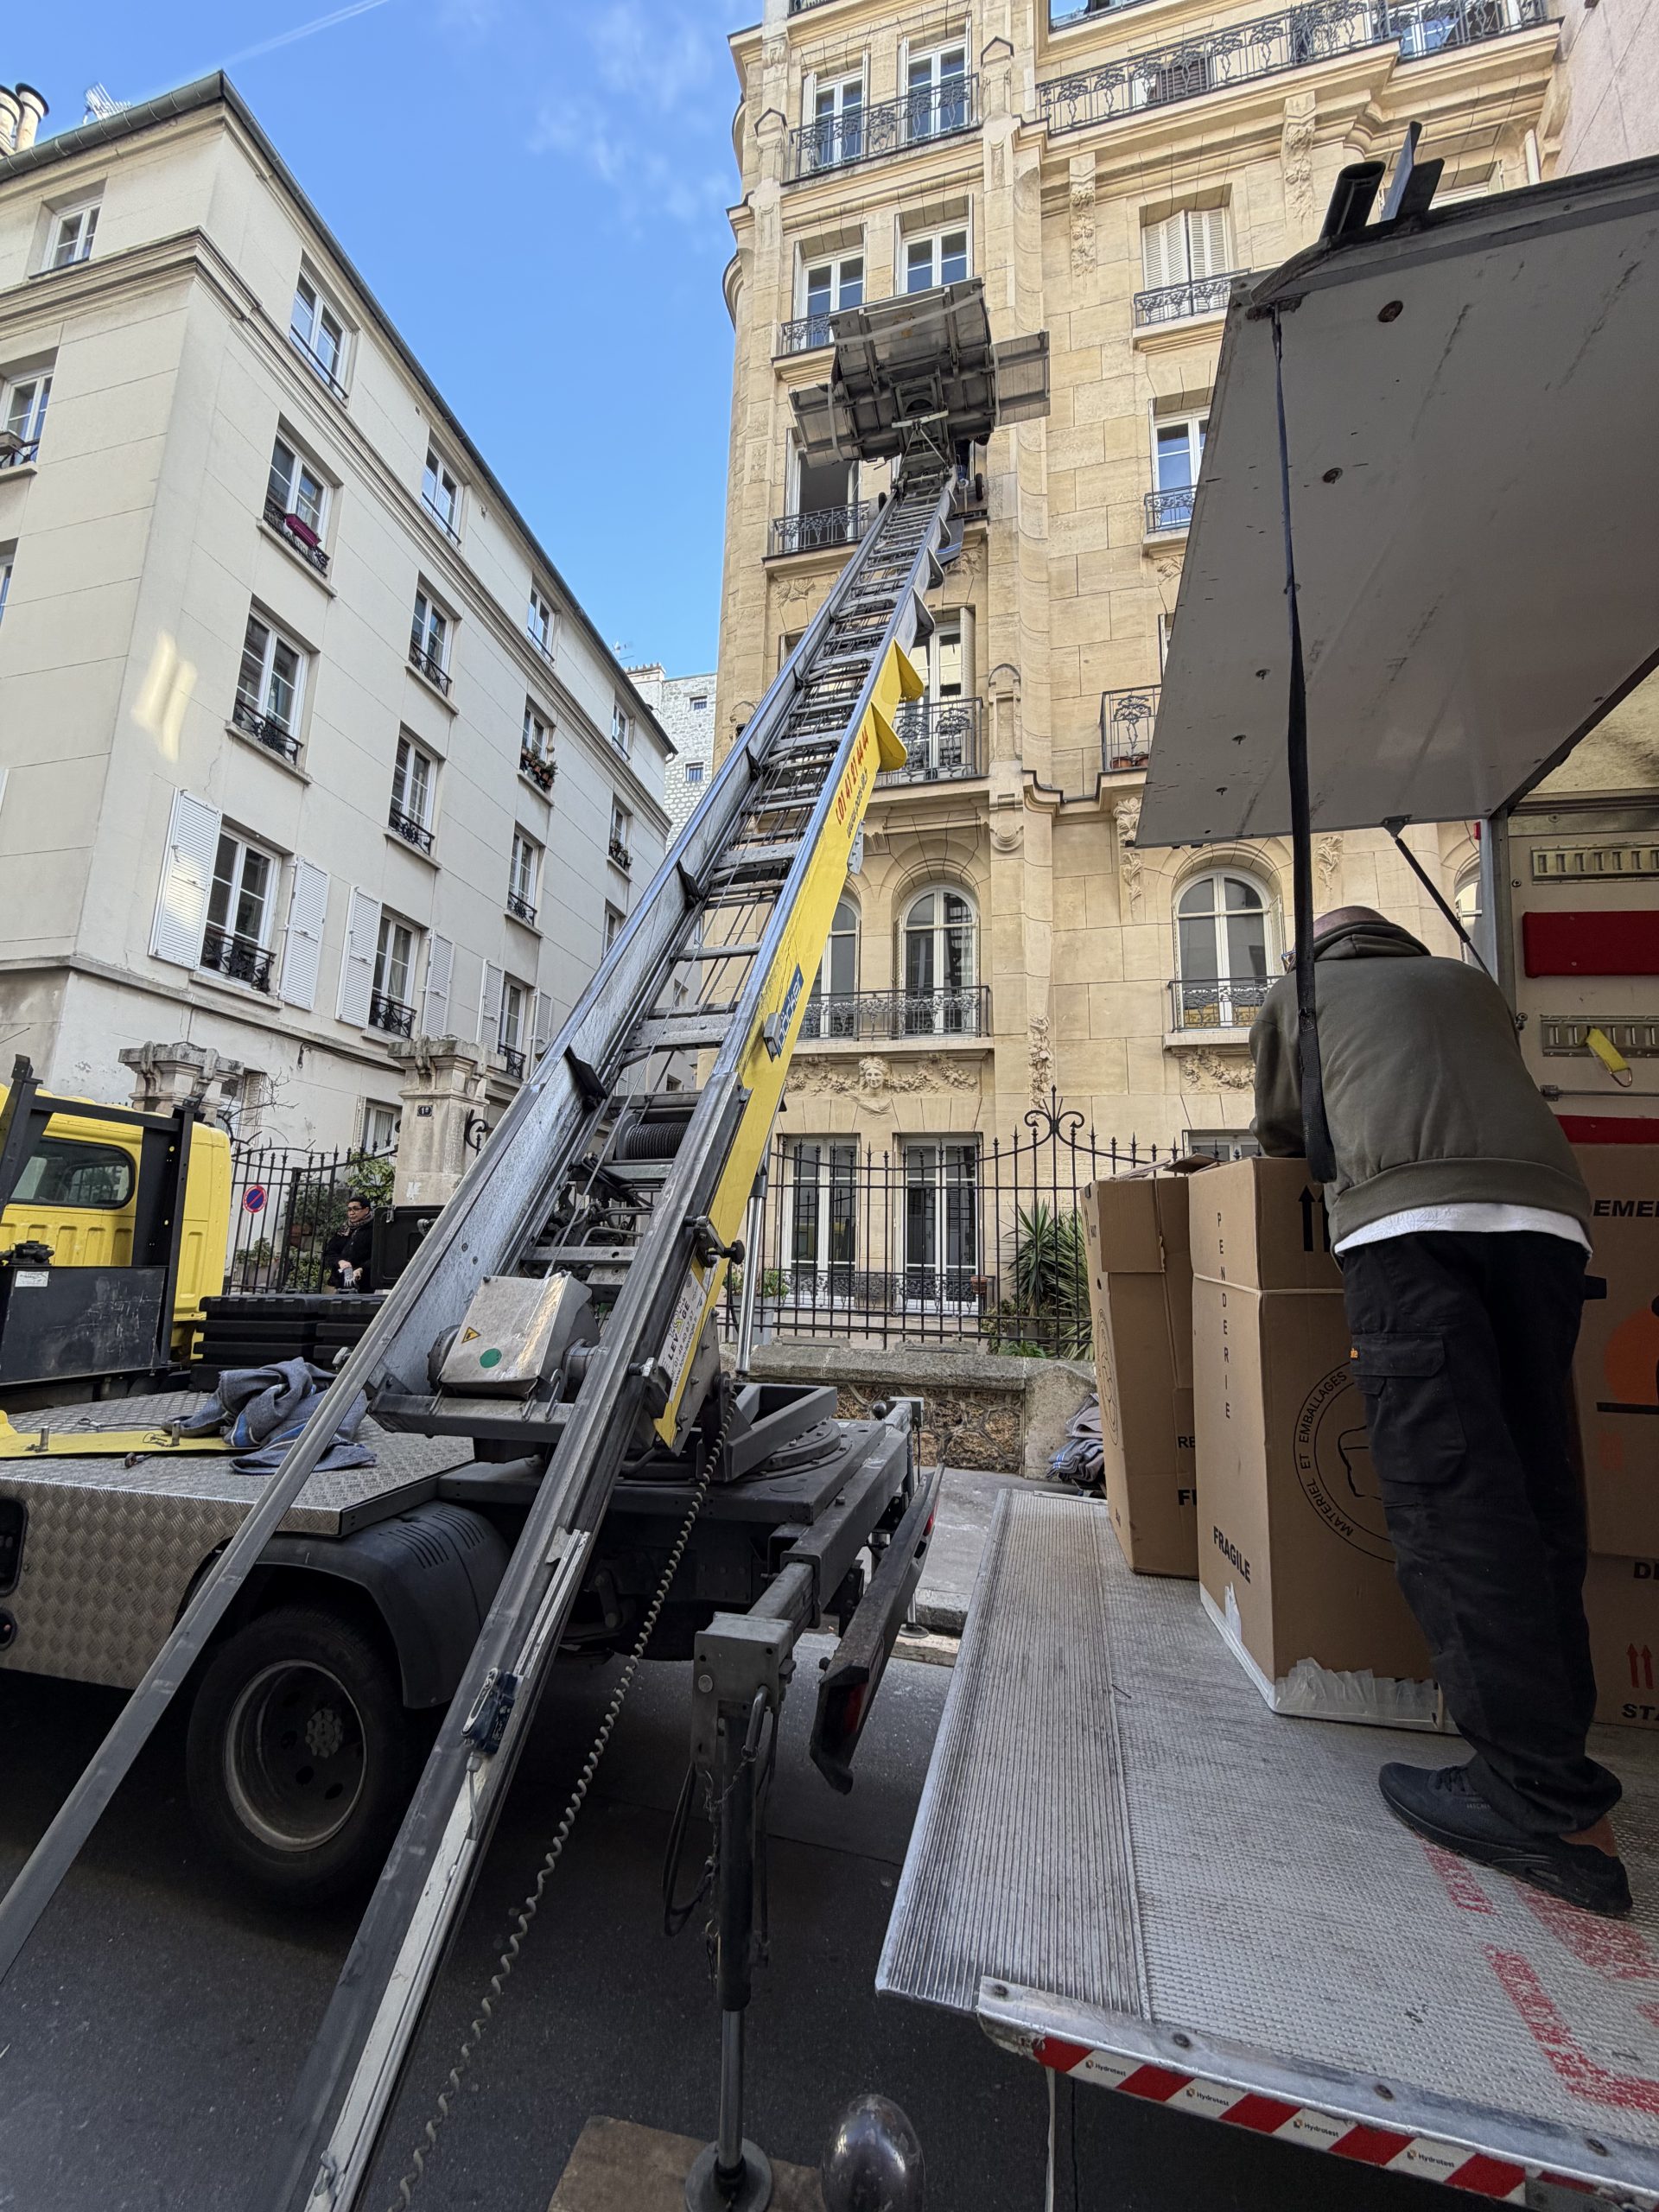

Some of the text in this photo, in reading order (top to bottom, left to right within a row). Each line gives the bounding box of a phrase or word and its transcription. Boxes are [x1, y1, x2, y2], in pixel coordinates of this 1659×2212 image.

[1592, 1199, 1659, 1217] EME
[1217, 1211, 1230, 1419] PENDERIE
[1299, 1371, 1354, 1536] MATERIEL ET EMBALLAGES
[1213, 1526, 1251, 1584] FRAGILE
